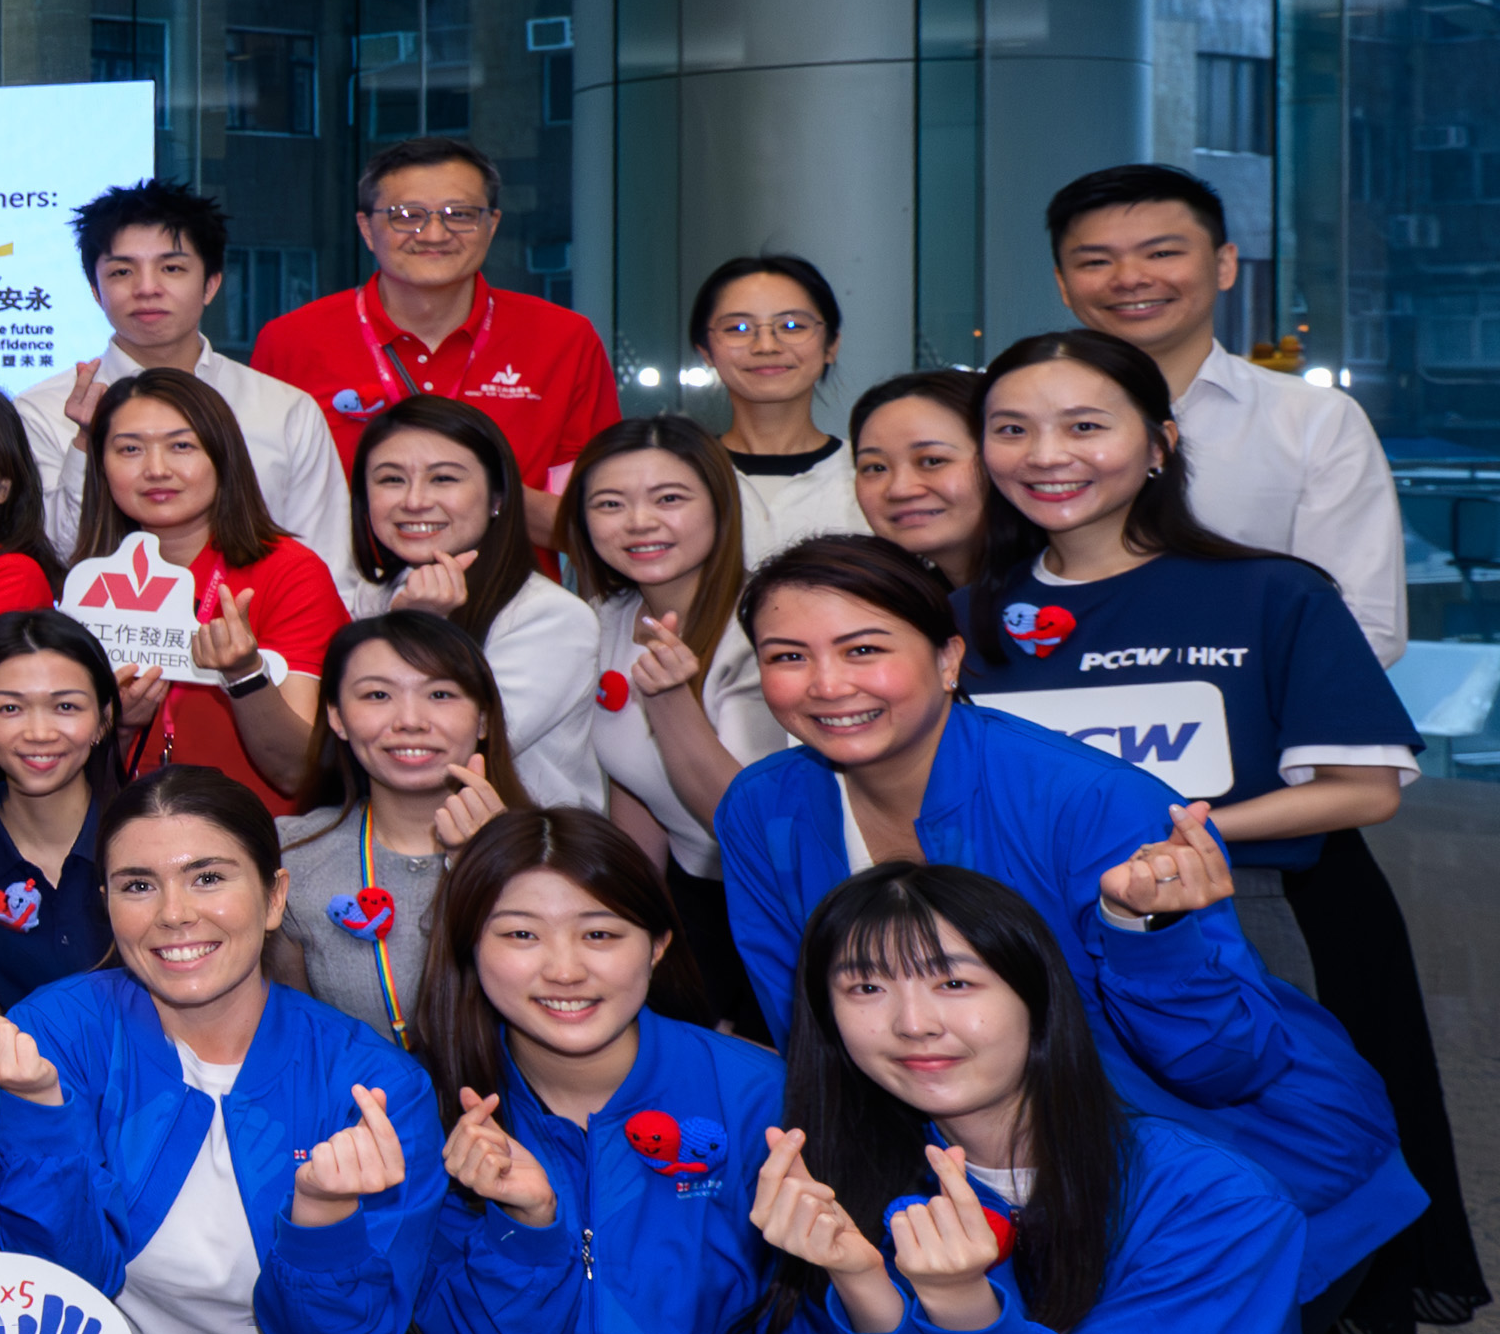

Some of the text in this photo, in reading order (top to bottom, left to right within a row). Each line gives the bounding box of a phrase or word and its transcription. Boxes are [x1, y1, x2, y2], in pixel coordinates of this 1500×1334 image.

[10, 323, 55, 336] future
[80, 620, 198, 650] 工作發展
[1079, 646, 1250, 672] PCCW HKT
